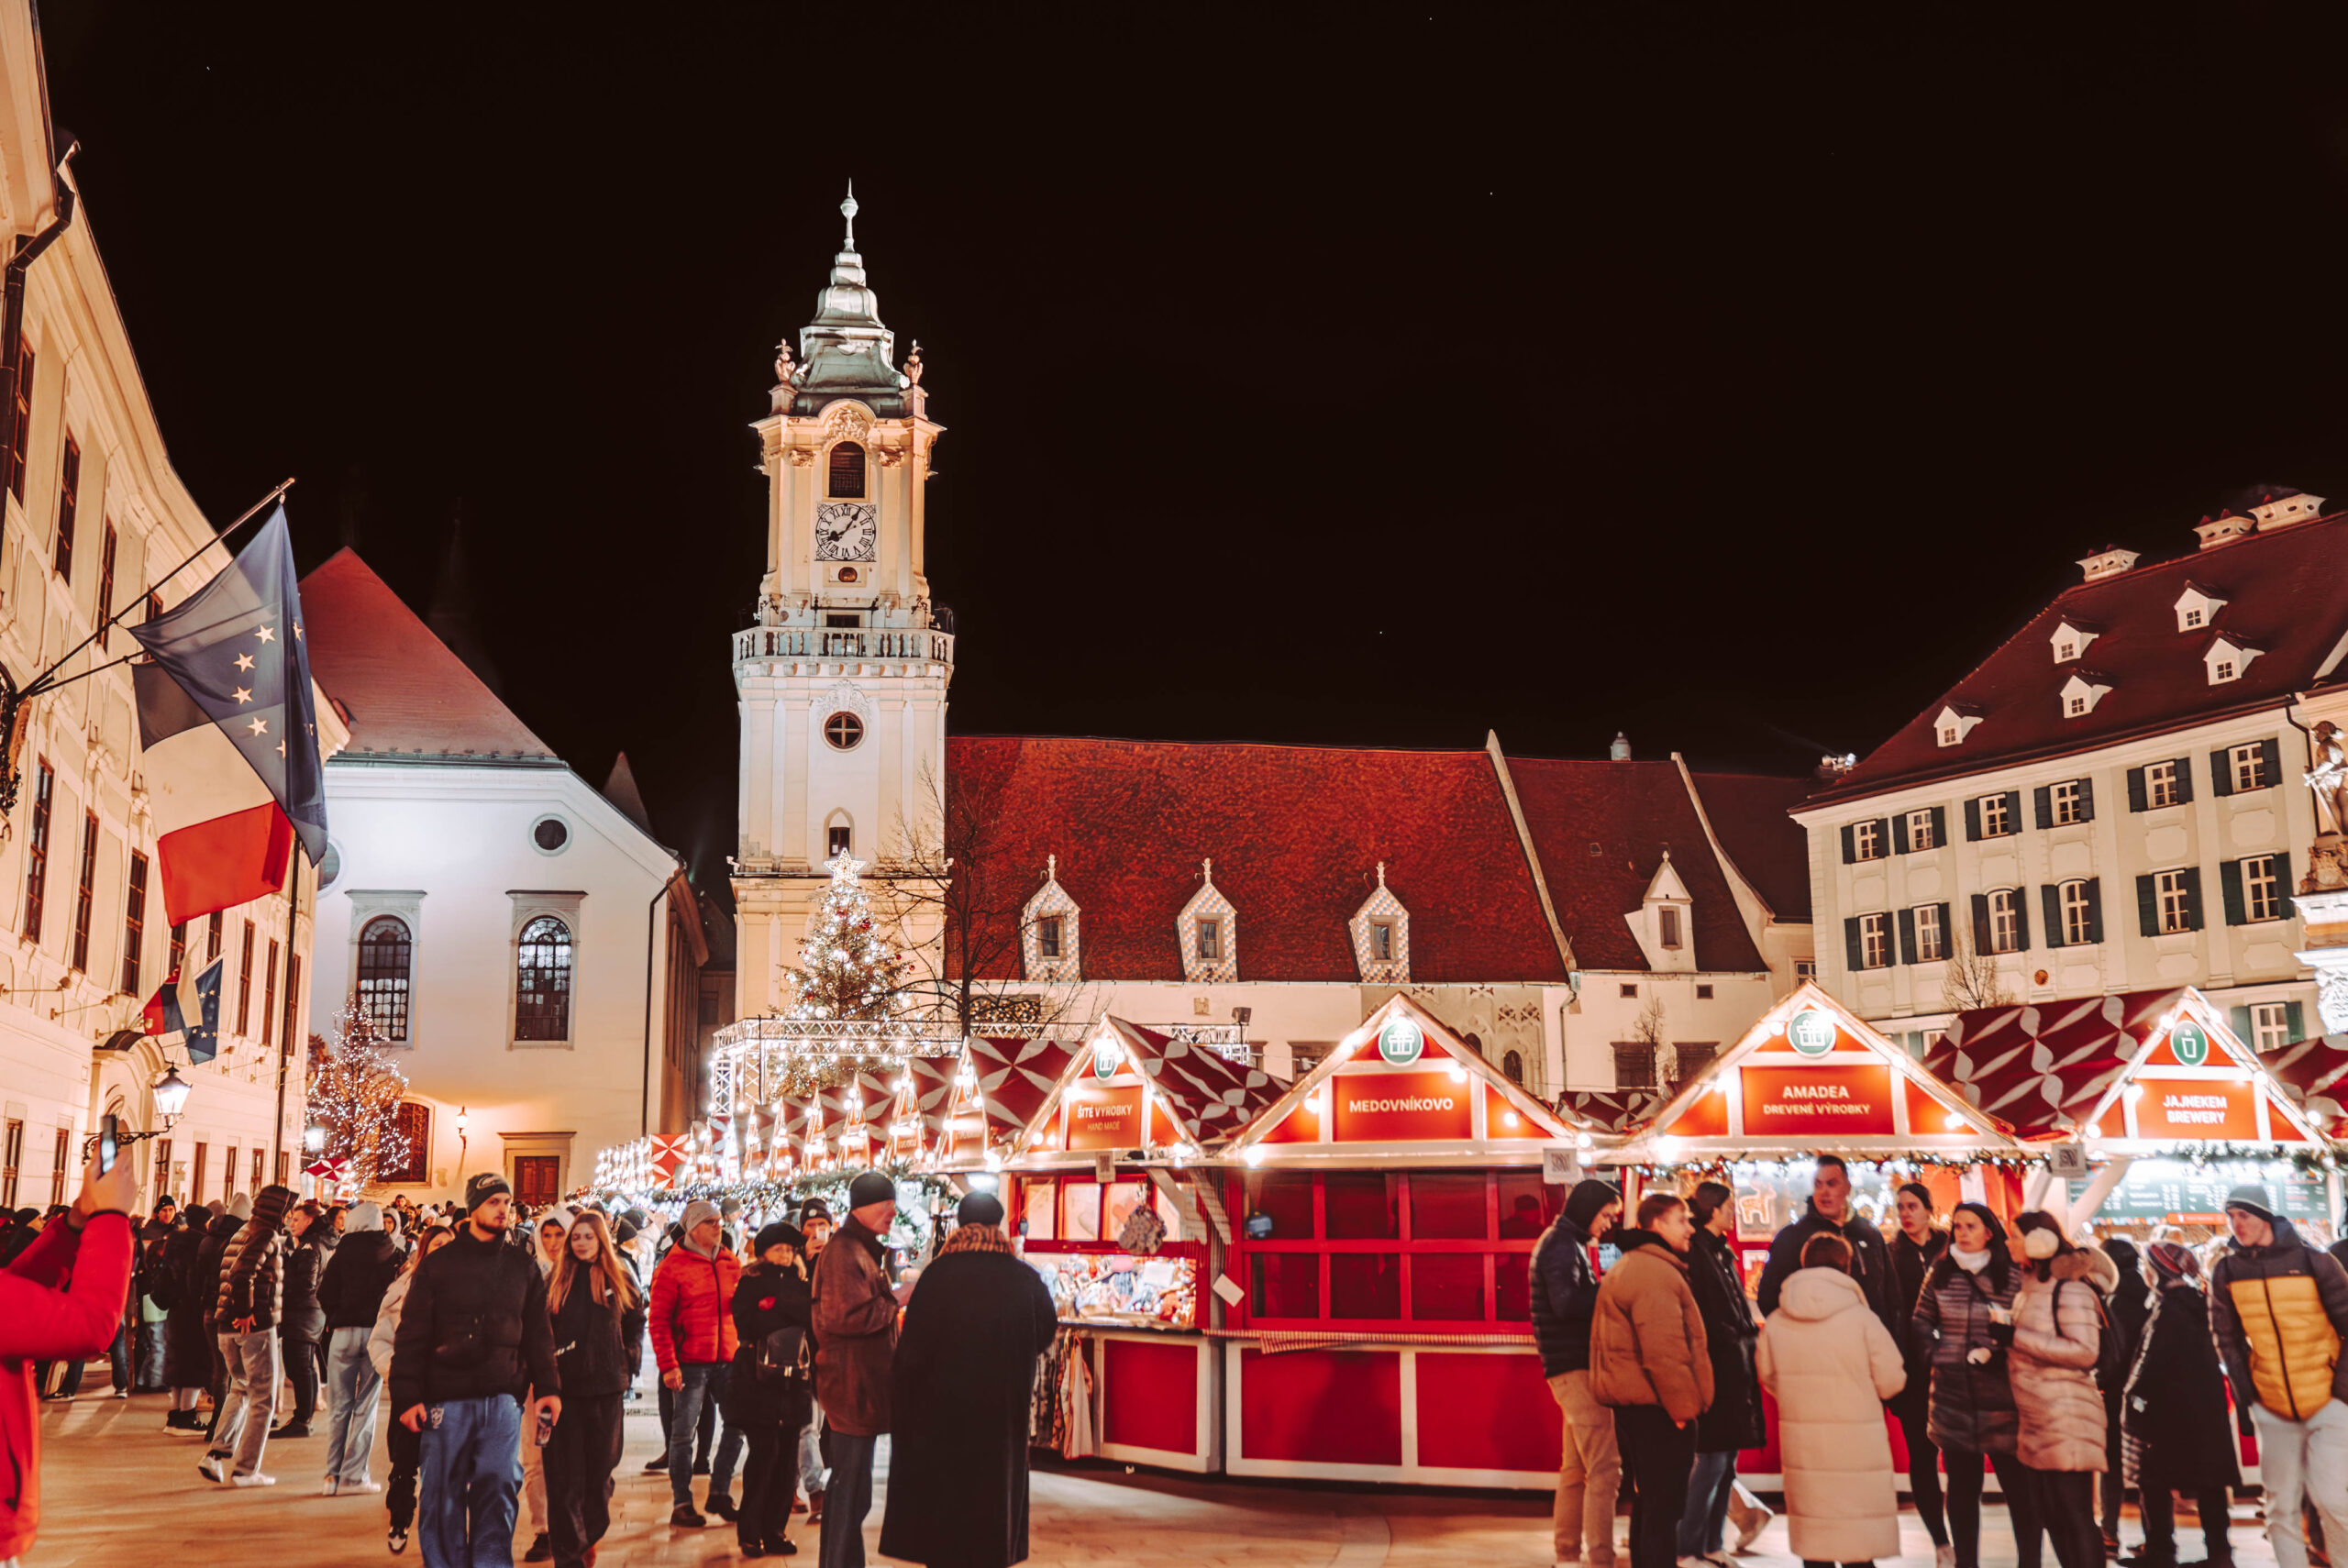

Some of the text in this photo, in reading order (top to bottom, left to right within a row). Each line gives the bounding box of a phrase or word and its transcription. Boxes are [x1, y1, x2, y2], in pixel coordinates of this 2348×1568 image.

[841, 507, 851, 516] XII
[1783, 1086, 1850, 1099] AMADEA
[1349, 1095, 1454, 1113] MEDOVNÍKOVO
[1763, 1101, 1871, 1115] DREVENÉ VÝROBKY
[2163, 1094, 2228, 1109] JAJNEKEM
[2166, 1110, 2226, 1124] BREWERY
